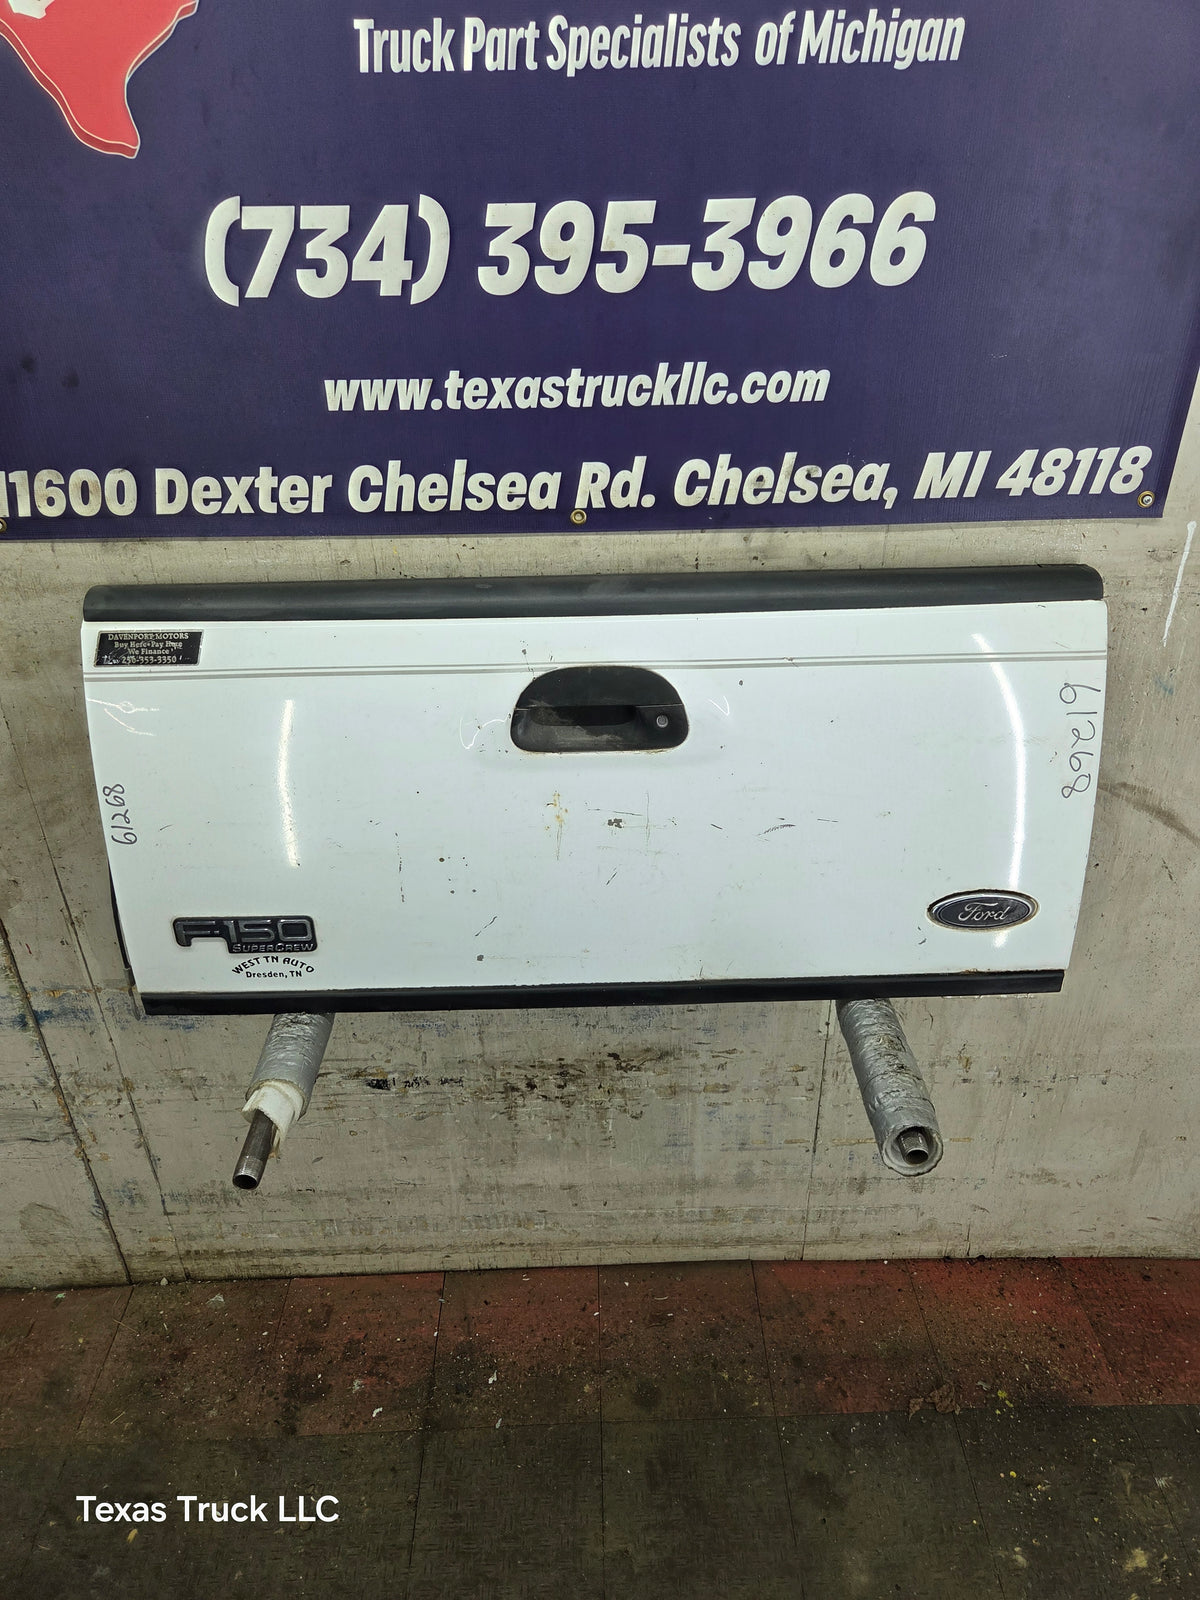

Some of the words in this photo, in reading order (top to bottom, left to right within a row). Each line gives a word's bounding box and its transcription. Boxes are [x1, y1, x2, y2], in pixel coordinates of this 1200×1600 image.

[353, 17, 456, 73] Truck
[463, 16, 540, 71] Part
[546, 14, 741, 77] Specialists
[754, 11, 796, 66] of
[797, 8, 966, 70] Michigan
[204, 193, 451, 307] (734)
[477, 191, 936, 296] 395-3966
[324, 361, 831, 412] www.texastruckllc.com
[154, 466, 333, 514] Dexter
[347, 459, 562, 512] Chelsea
[576, 455, 656, 509] Rd.
[674, 452, 898, 509] Chelsea,
[913, 450, 992, 500] MI
[996, 445, 1153, 496] 48118
[108, 633, 153, 641] DAVENPORT
[155, 632, 189, 640] MOTORS
[114, 641, 128, 649] Buy
[1058, 682, 1102, 799] 61268
[102, 783, 138, 845] 61268
[957, 902, 1010, 921] Ford
[232, 957, 261, 974] WEST
[282, 957, 315, 973] AUTO
[245, 971, 288, 979] Dresden,
